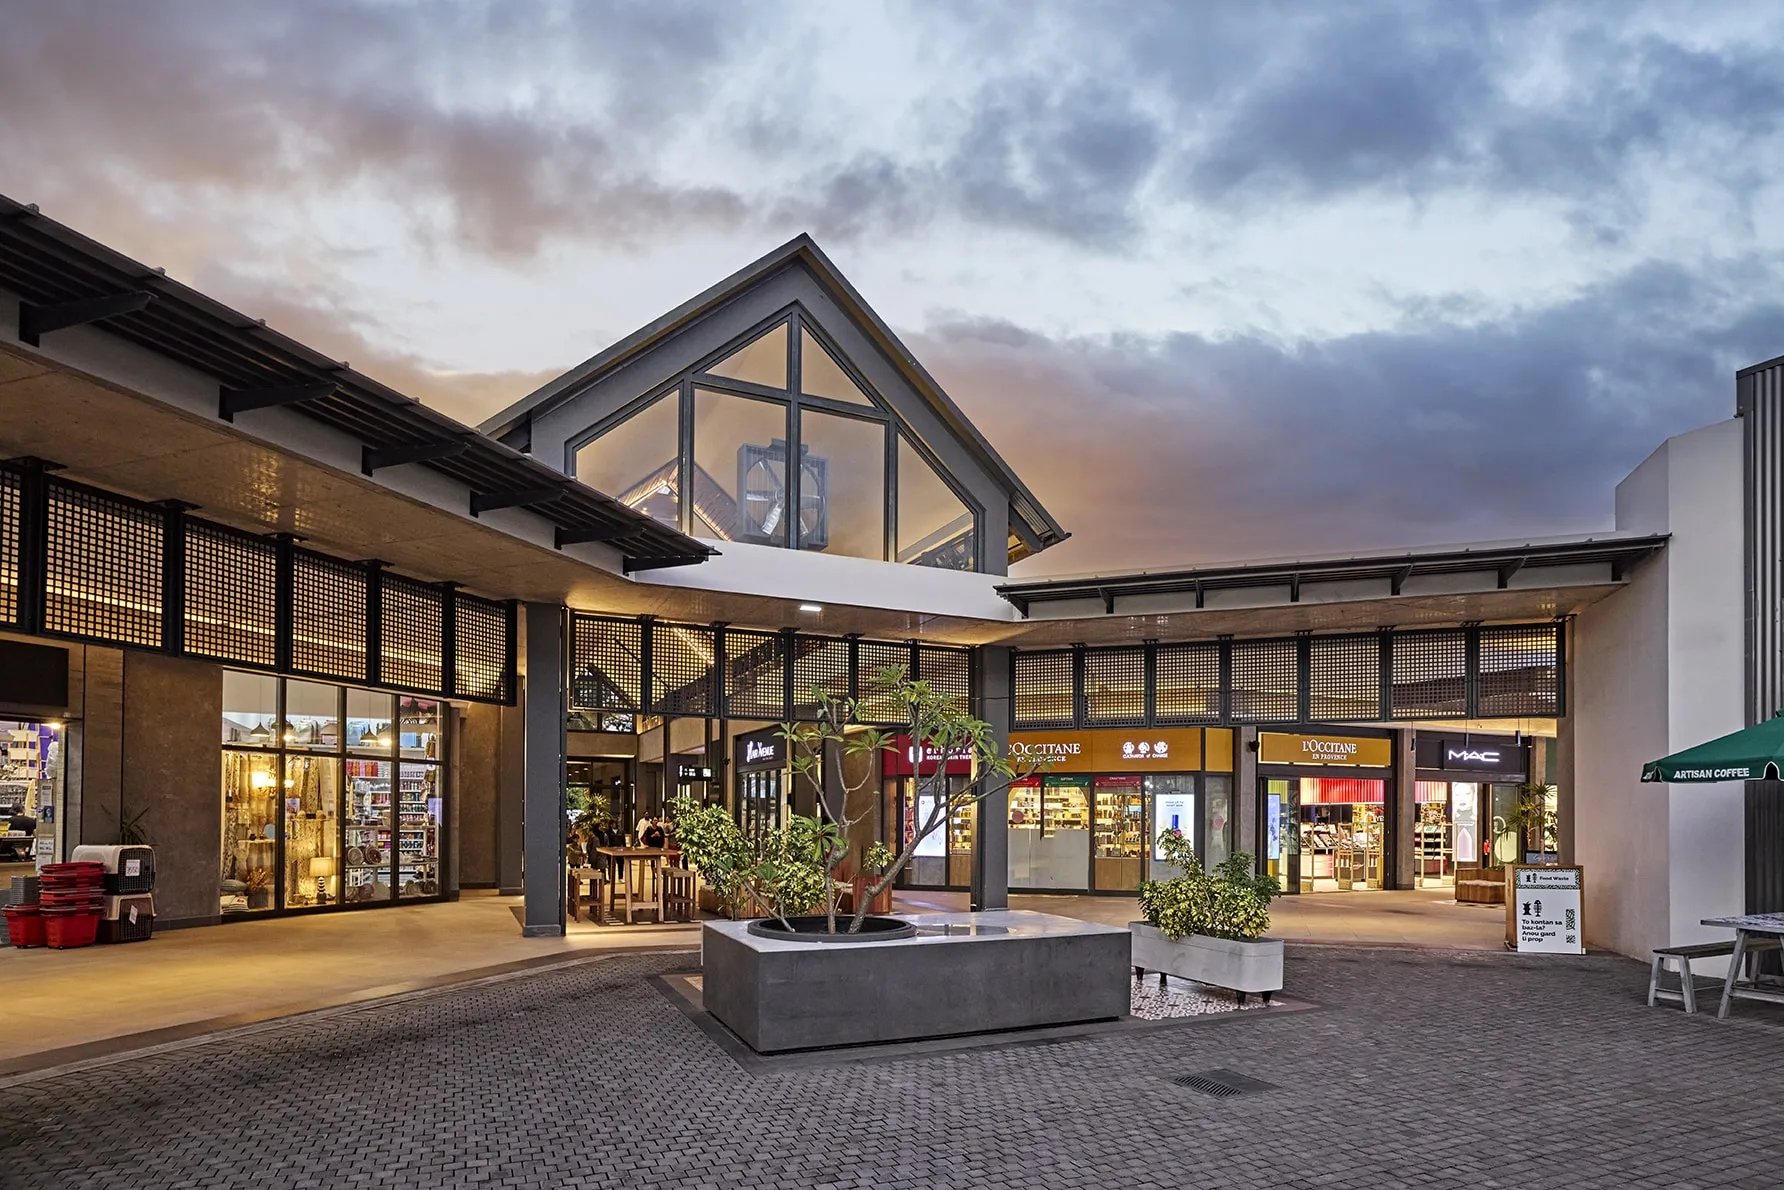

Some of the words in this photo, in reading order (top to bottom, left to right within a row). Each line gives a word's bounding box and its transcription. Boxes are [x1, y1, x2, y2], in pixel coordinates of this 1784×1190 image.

[1448, 749, 1500, 762] MAC
[1673, 769, 1712, 779] ARTISAN
[1713, 768, 1750, 778] COFFEE
